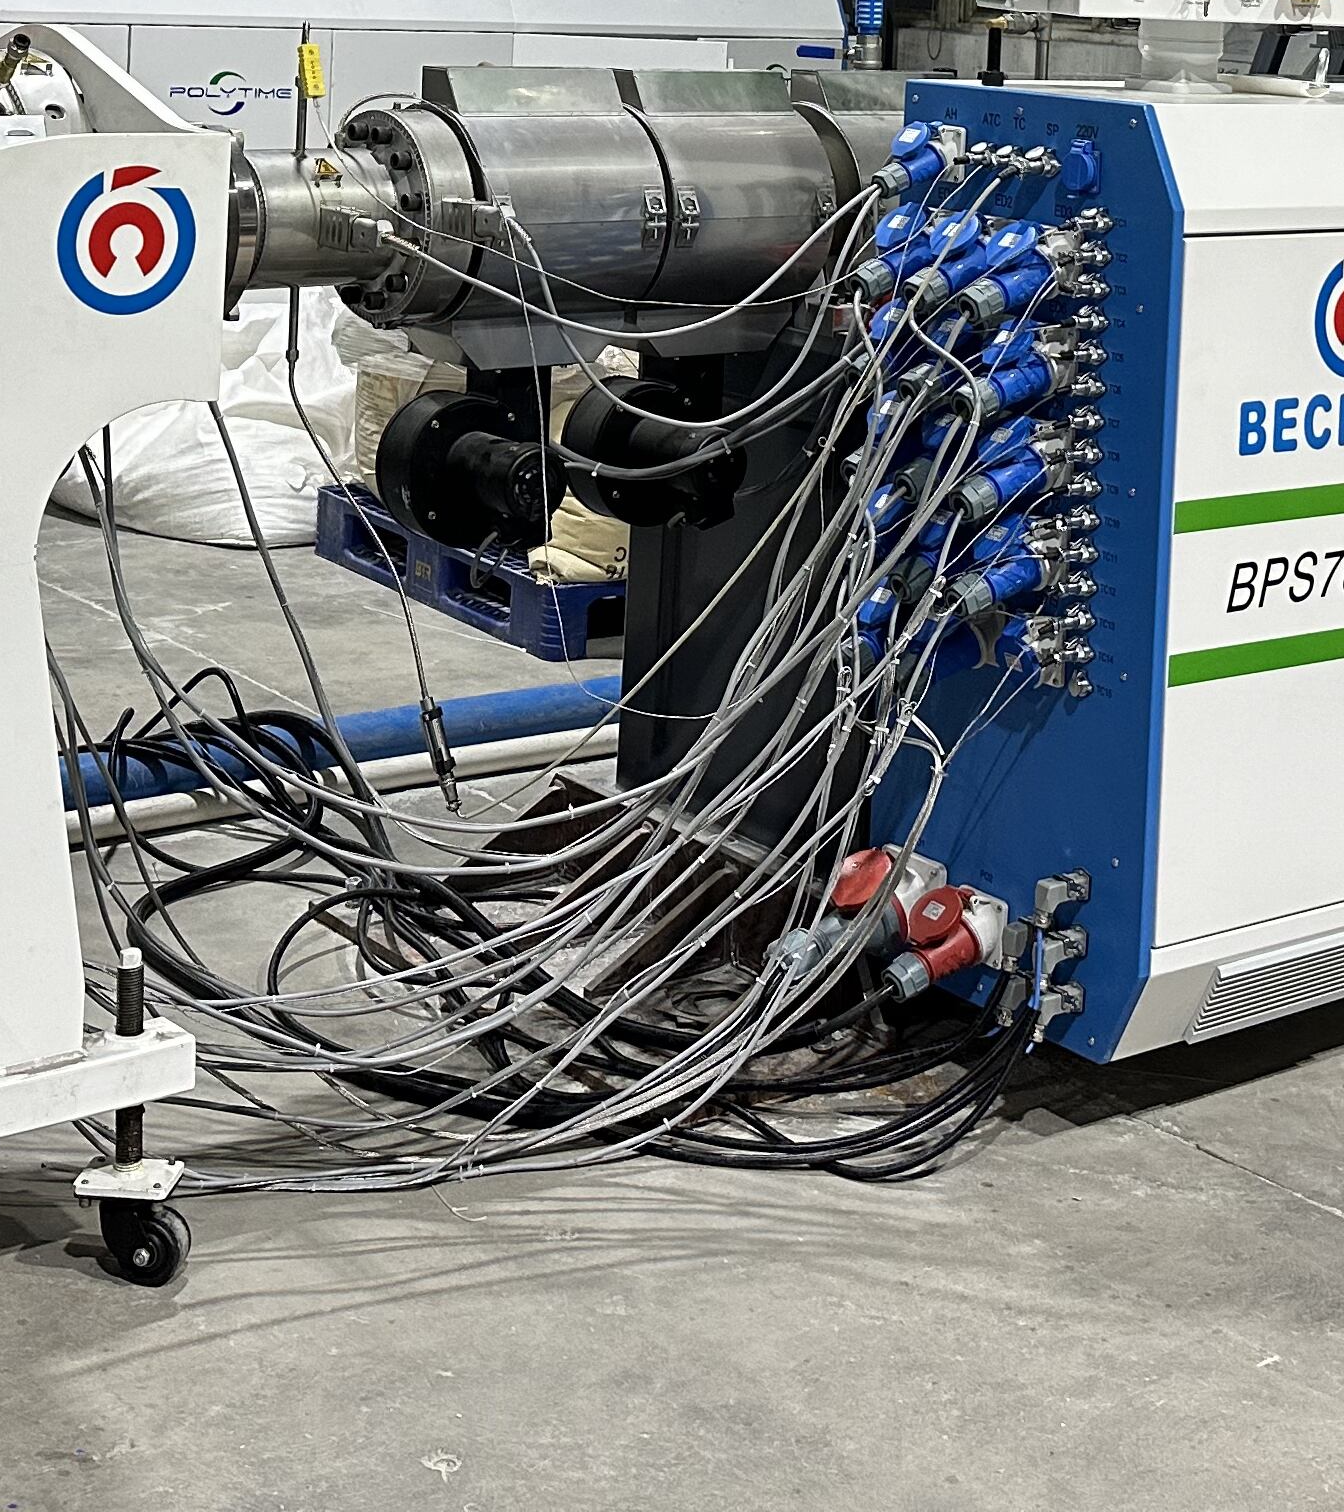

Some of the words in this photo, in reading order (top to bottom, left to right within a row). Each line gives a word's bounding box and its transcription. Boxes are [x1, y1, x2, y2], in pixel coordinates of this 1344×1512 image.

[169, 85, 293, 99] POLYTIME
[944, 107, 958, 121] AH
[982, 112, 1001, 128] ATC
[1013, 116, 1027, 131] TC
[1045, 122, 1060, 136] SP
[1075, 123, 1100, 140] 220V
[994, 193, 1014, 210] ED2
[1101, 550, 1118, 565] TC11
[1097, 649, 1114, 665] TC14
